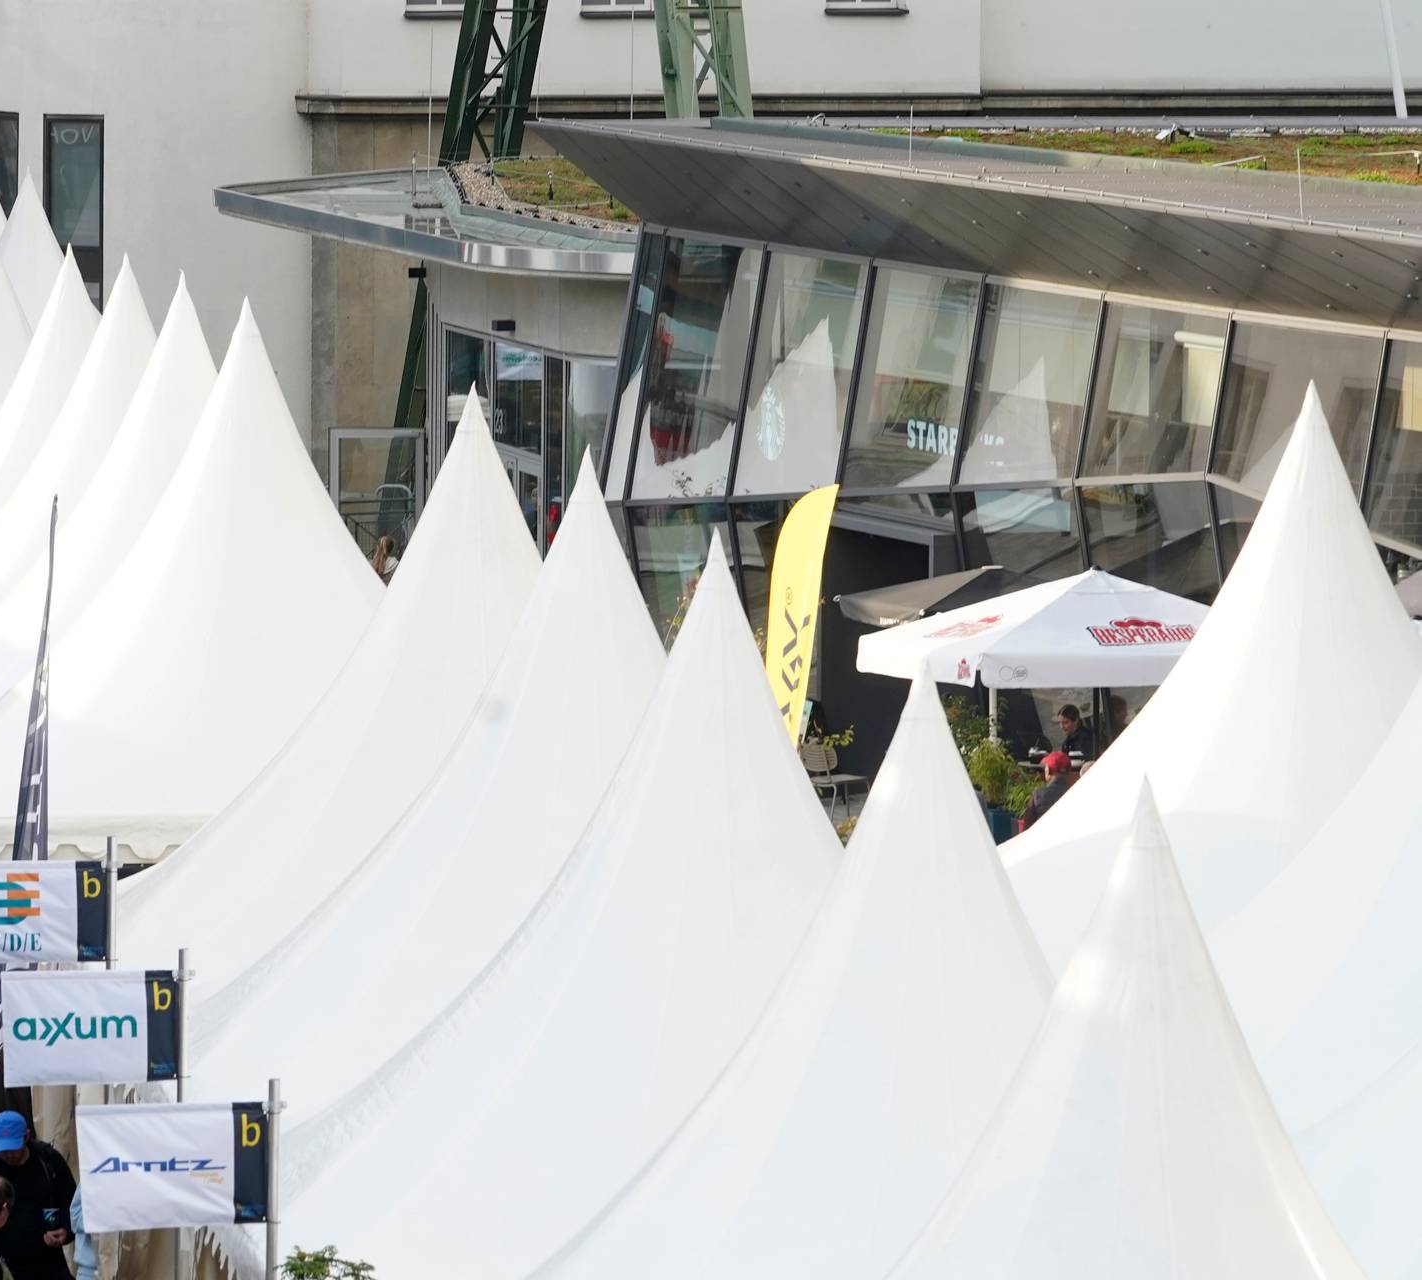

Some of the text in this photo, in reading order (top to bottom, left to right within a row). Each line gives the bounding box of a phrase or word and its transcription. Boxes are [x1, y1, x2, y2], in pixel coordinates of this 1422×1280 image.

[83, 870, 101, 898] b
[153, 980, 172, 1011] b
[241, 1113, 261, 1147] b
[90, 1156, 227, 1174] Arntz
